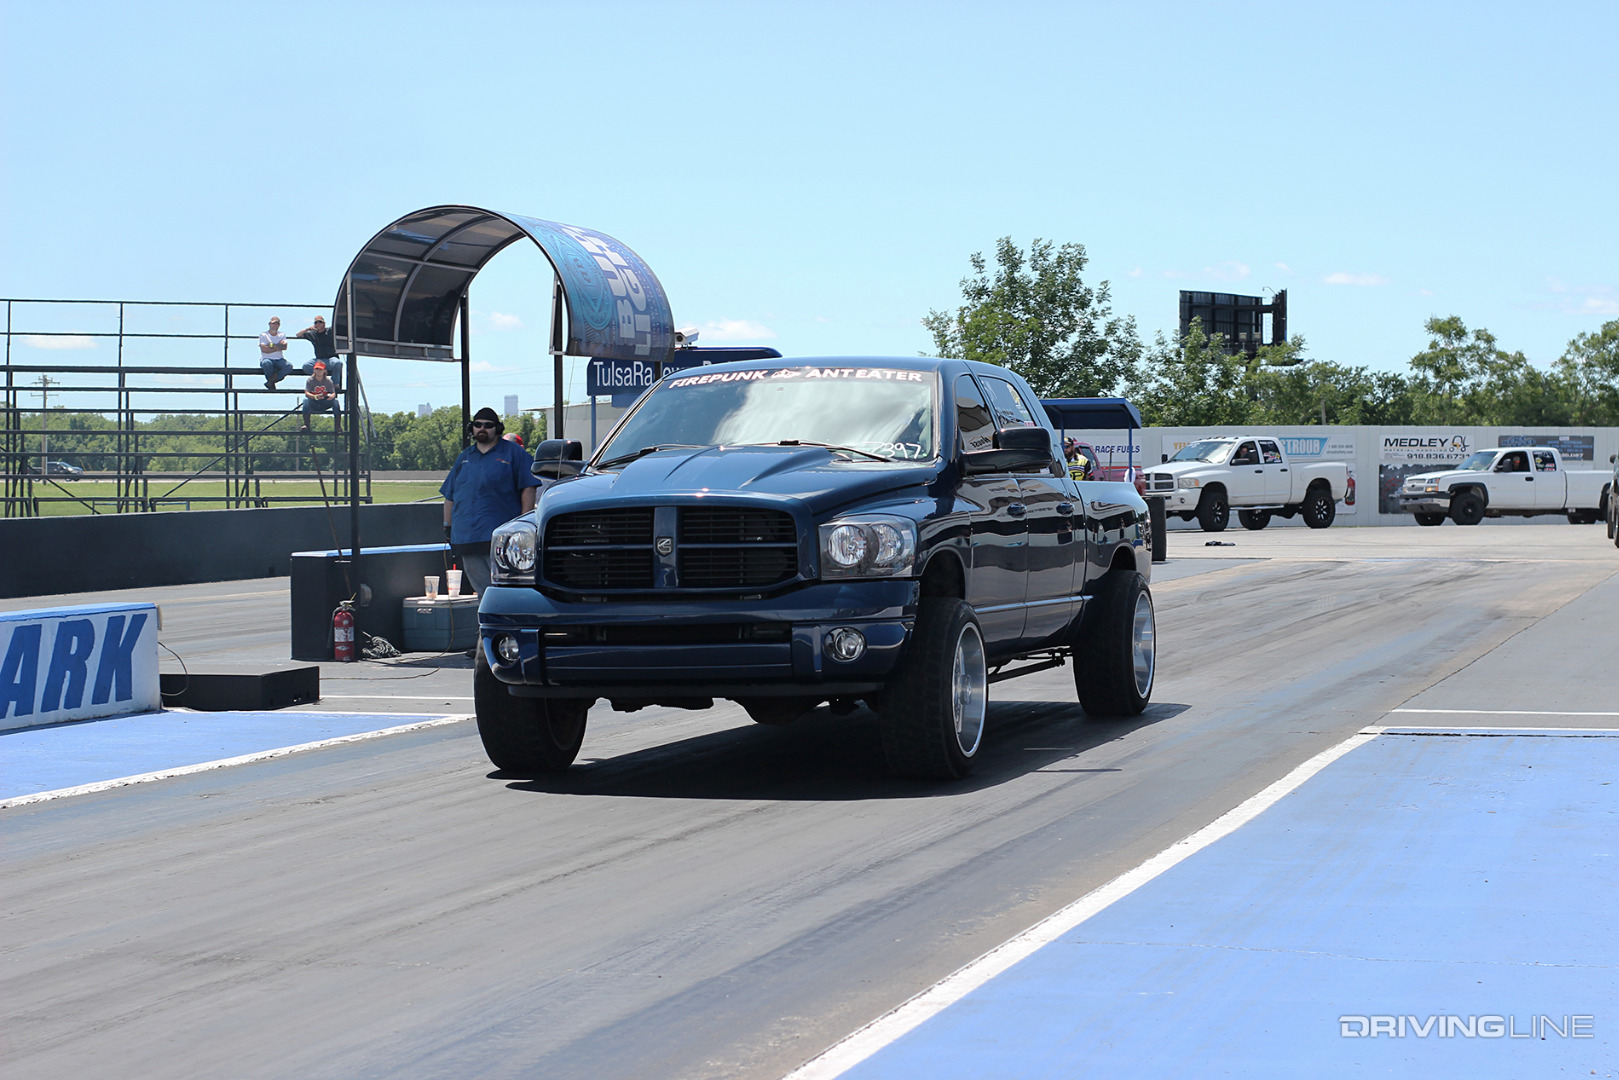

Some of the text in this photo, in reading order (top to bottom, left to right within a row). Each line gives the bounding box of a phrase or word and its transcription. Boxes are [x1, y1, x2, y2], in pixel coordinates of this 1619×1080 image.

[558, 223, 651, 356] LIGHT
[561, 228, 635, 339] BUD
[668, 370, 768, 389] FIREPUNK
[1095, 445, 1115, 453] RACE
[1384, 438, 1449, 447] MEDLEY
[0, 613, 148, 719] ARK
